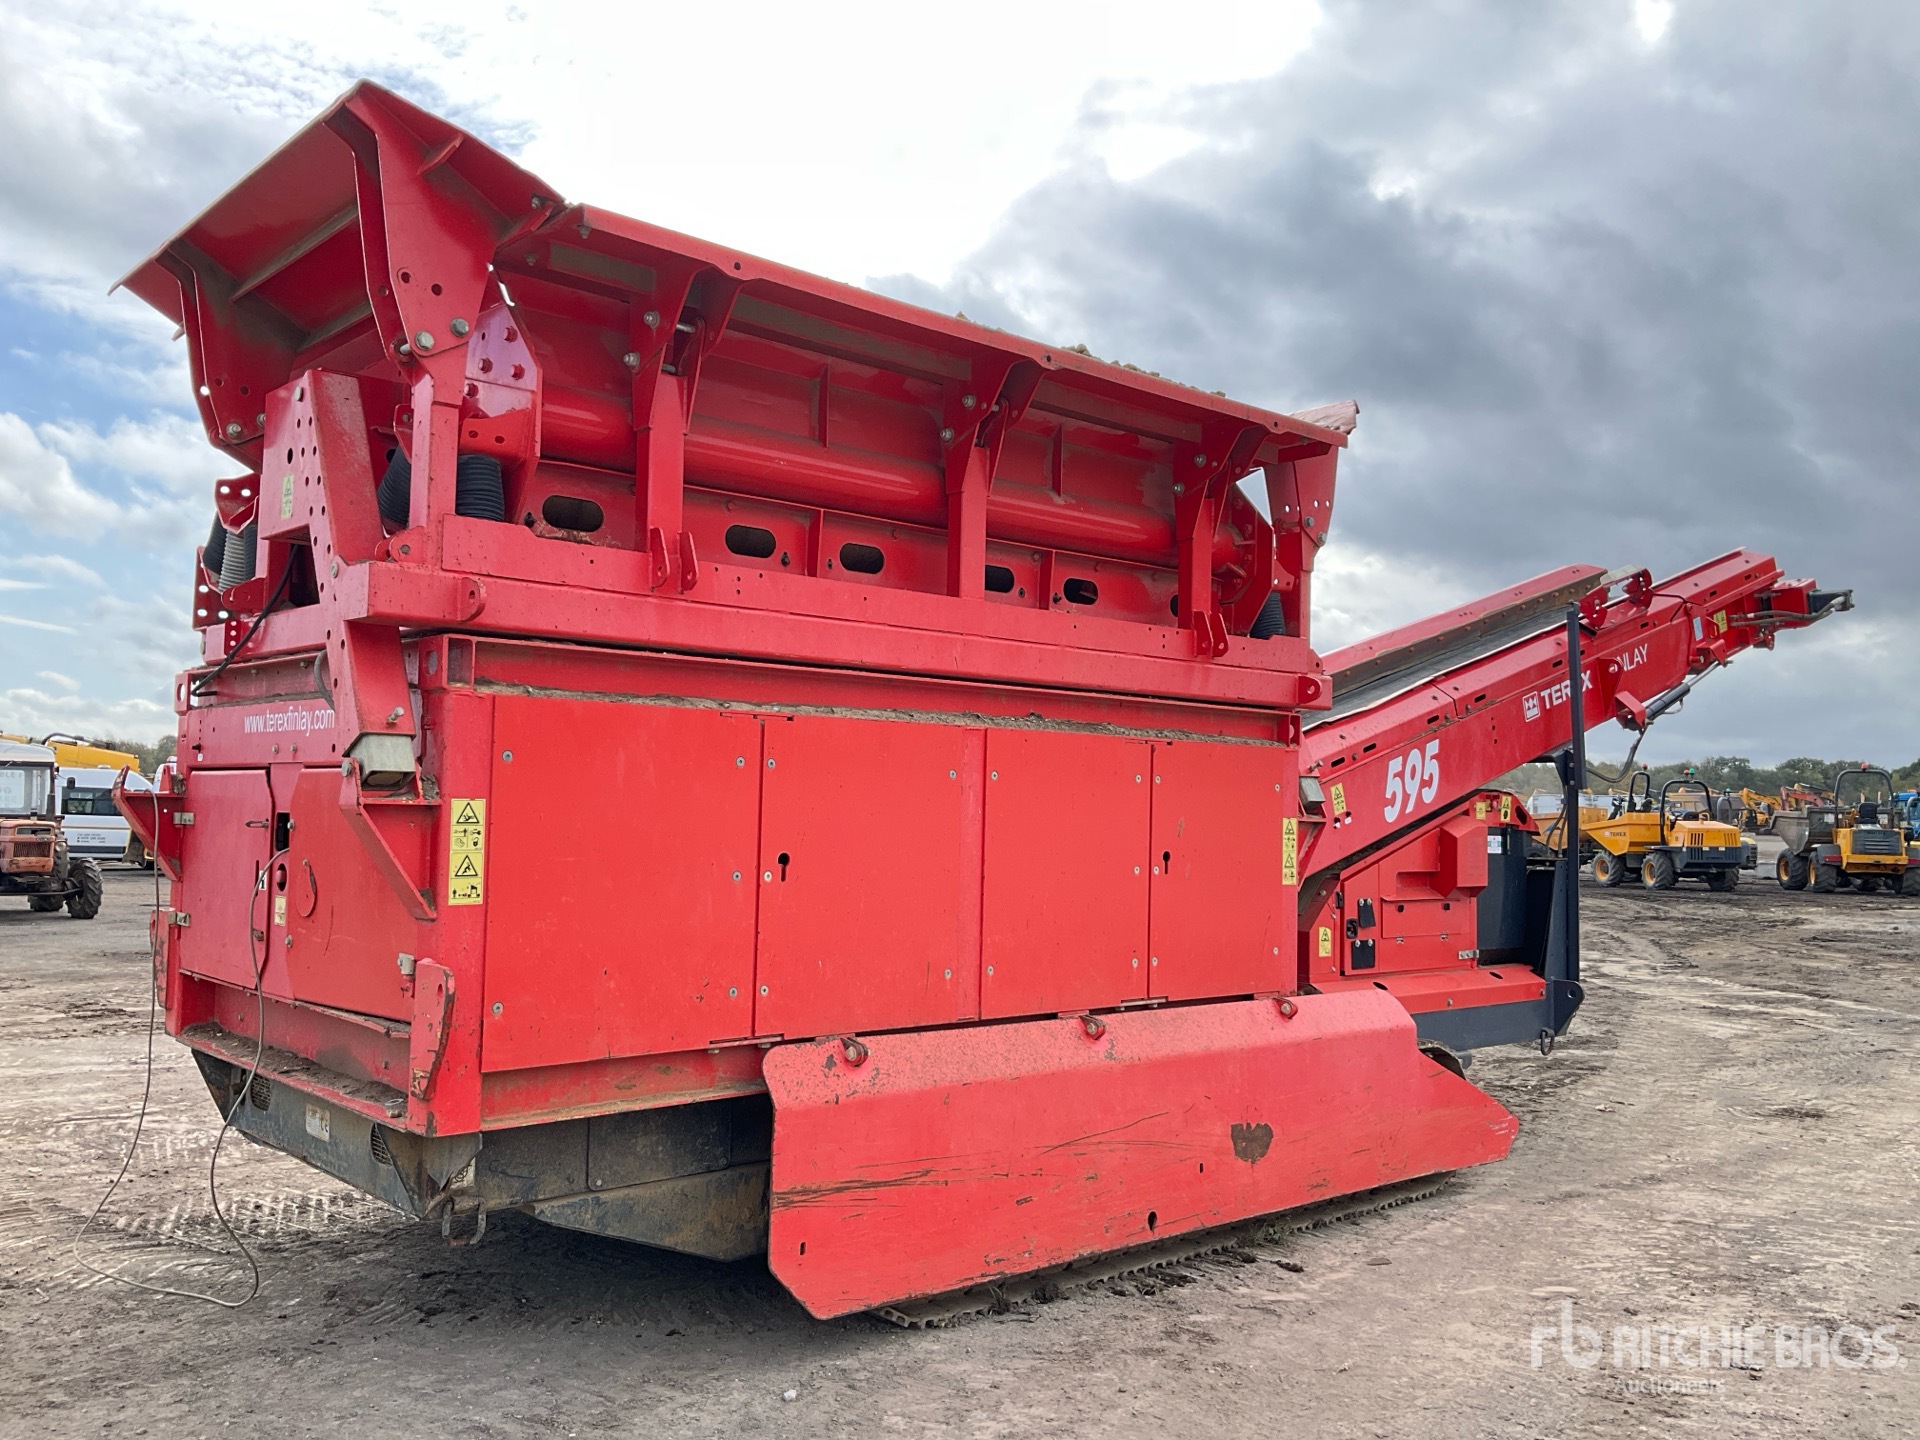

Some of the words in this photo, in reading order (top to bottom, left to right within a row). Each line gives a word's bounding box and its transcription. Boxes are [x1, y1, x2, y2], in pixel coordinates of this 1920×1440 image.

[1541, 669, 1593, 710] TERX
[1616, 643, 1648, 672] NLAY
[244, 705, 335, 737] www.terexfinlay.com
[1383, 738, 1440, 823] 595
